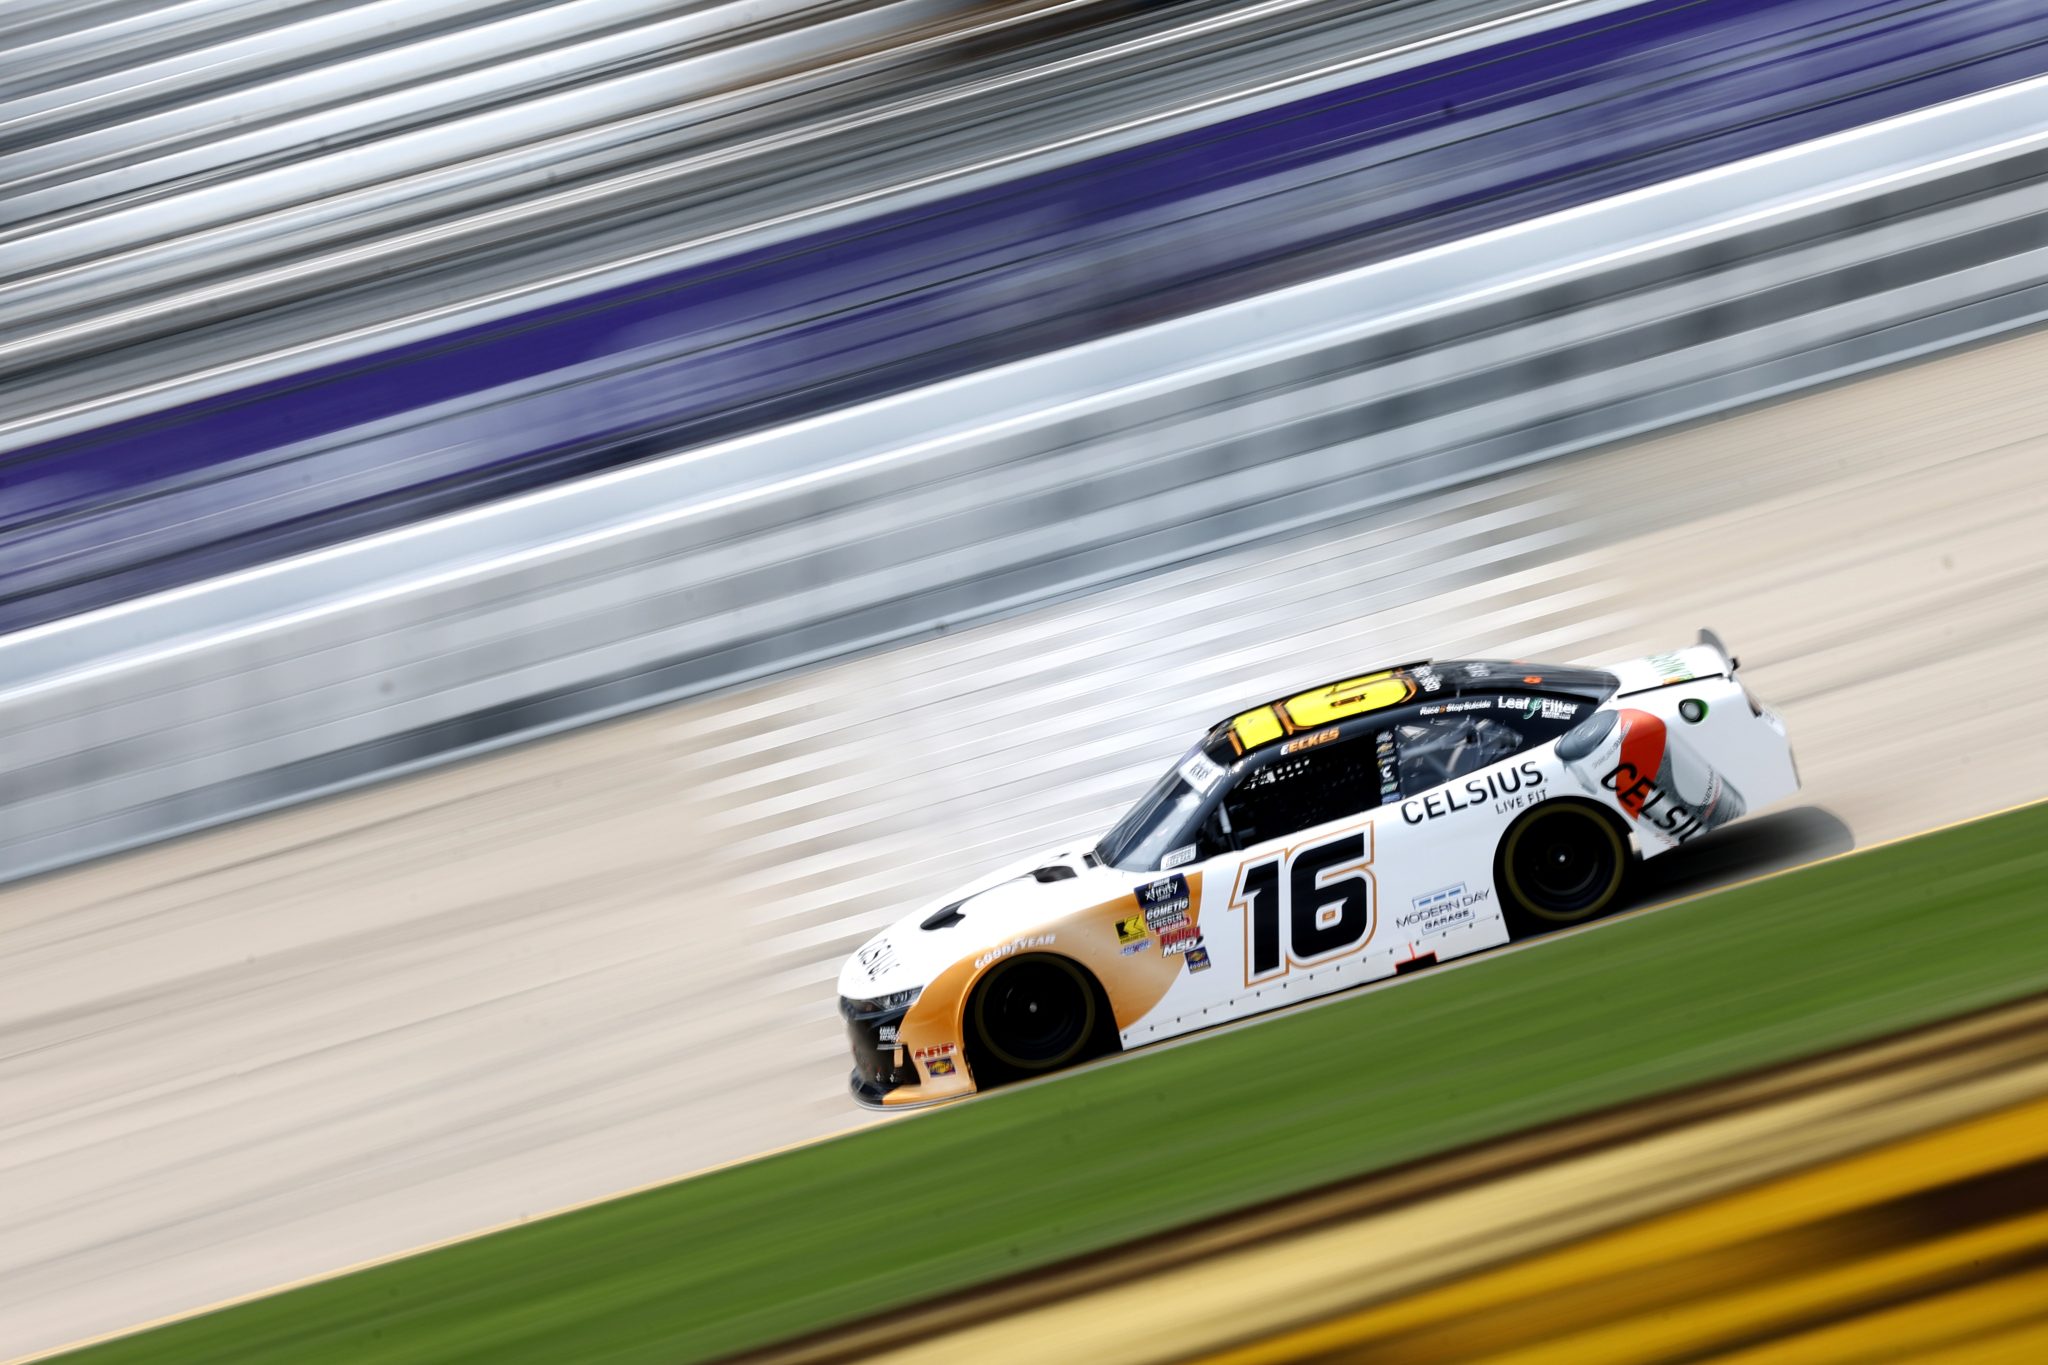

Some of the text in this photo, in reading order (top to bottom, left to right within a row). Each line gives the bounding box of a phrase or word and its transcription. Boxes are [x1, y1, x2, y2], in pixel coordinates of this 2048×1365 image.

[1498, 696, 1578, 714] Leaf Filter
[1289, 727, 1341, 753] ECKES
[1401, 761, 1544, 825] CELSIUS
[1495, 789, 1548, 815] LIVE FIT
[1147, 898, 1188, 920] COMETIC
[1230, 823, 1374, 984] 16
[1396, 888, 1490, 928] MODERN DAY
[1425, 909, 1469, 929] GARAGE
[1162, 937, 1198, 958] MSD
[915, 1043, 955, 1060] ARP
